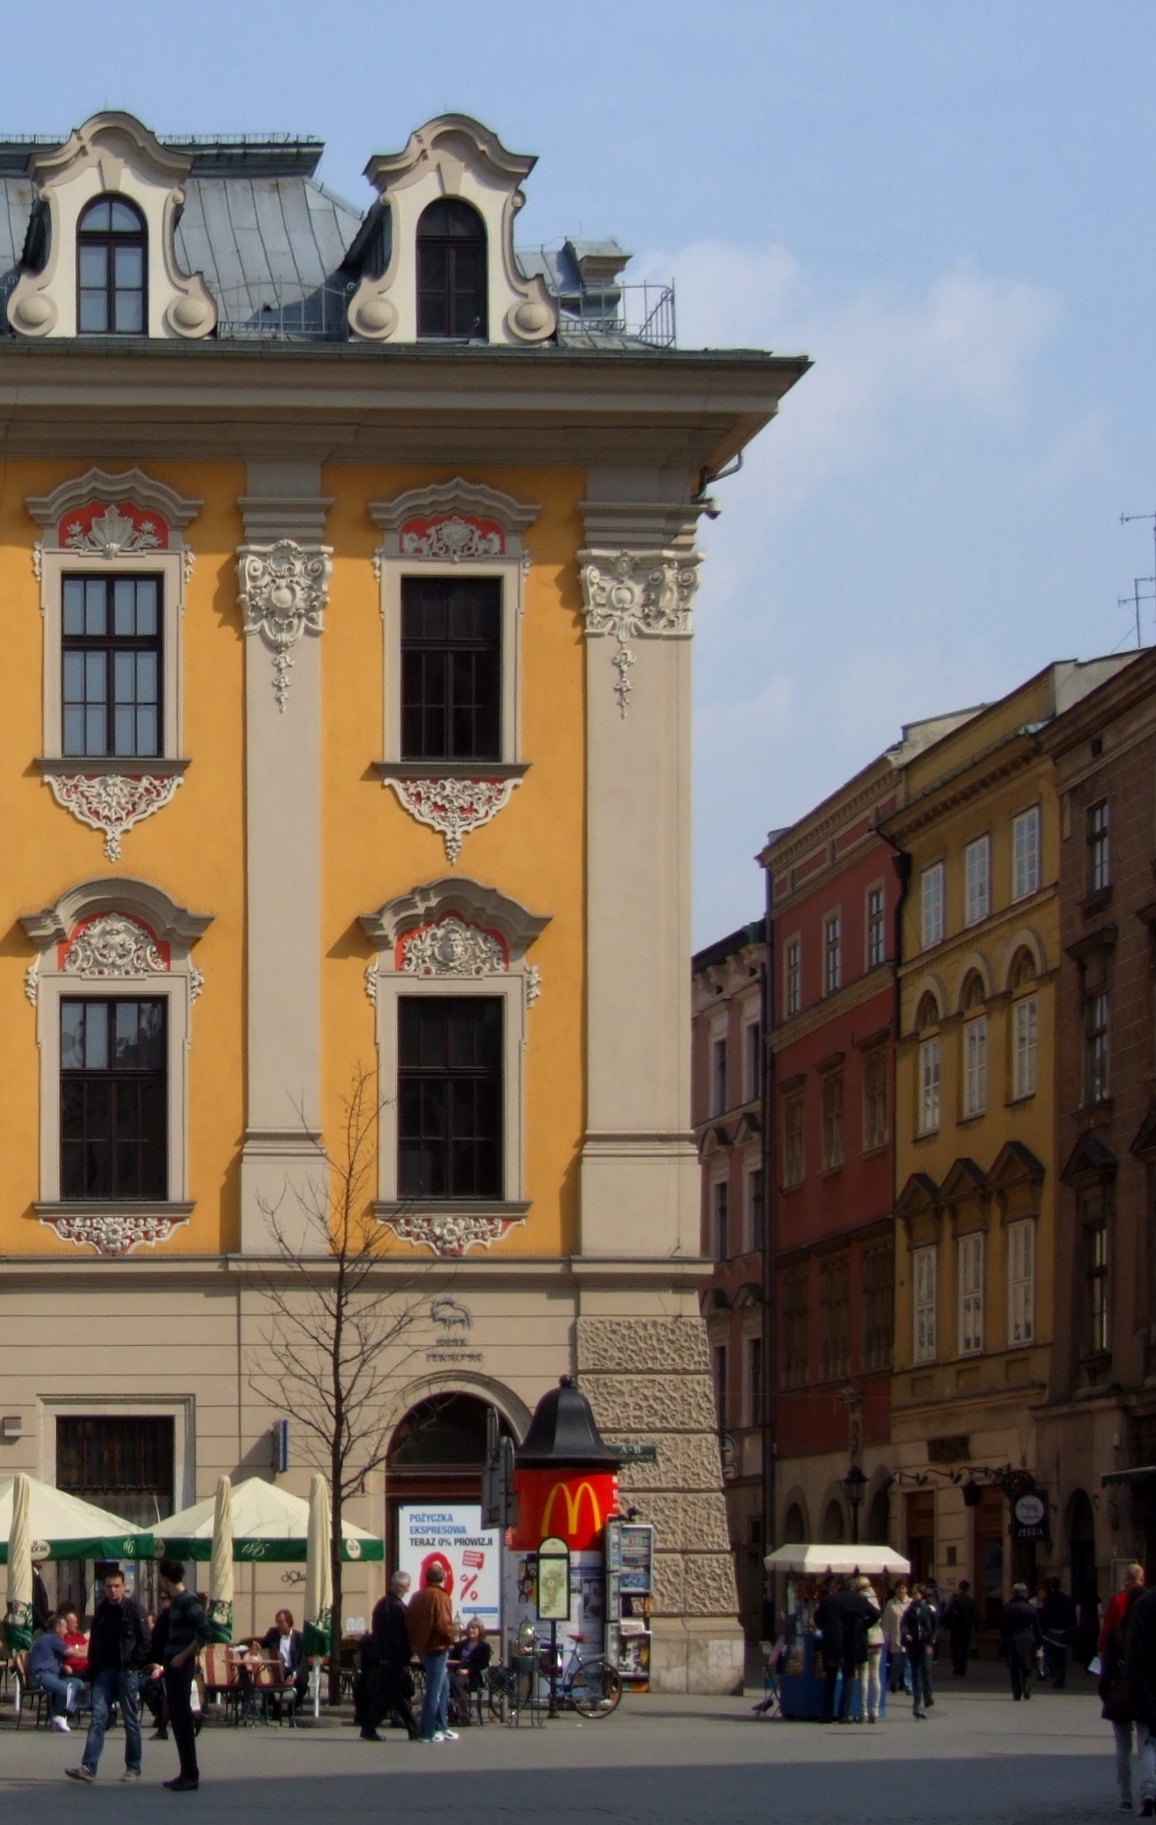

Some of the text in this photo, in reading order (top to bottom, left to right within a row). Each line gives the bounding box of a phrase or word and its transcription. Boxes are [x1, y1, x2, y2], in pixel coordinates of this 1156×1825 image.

[409, 1511, 454, 1523] POŻYCZKA
[409, 1525, 467, 1535] EKSPRESOWA
[409, 1537, 493, 1547] TERAZ 0% PROWIZJI
